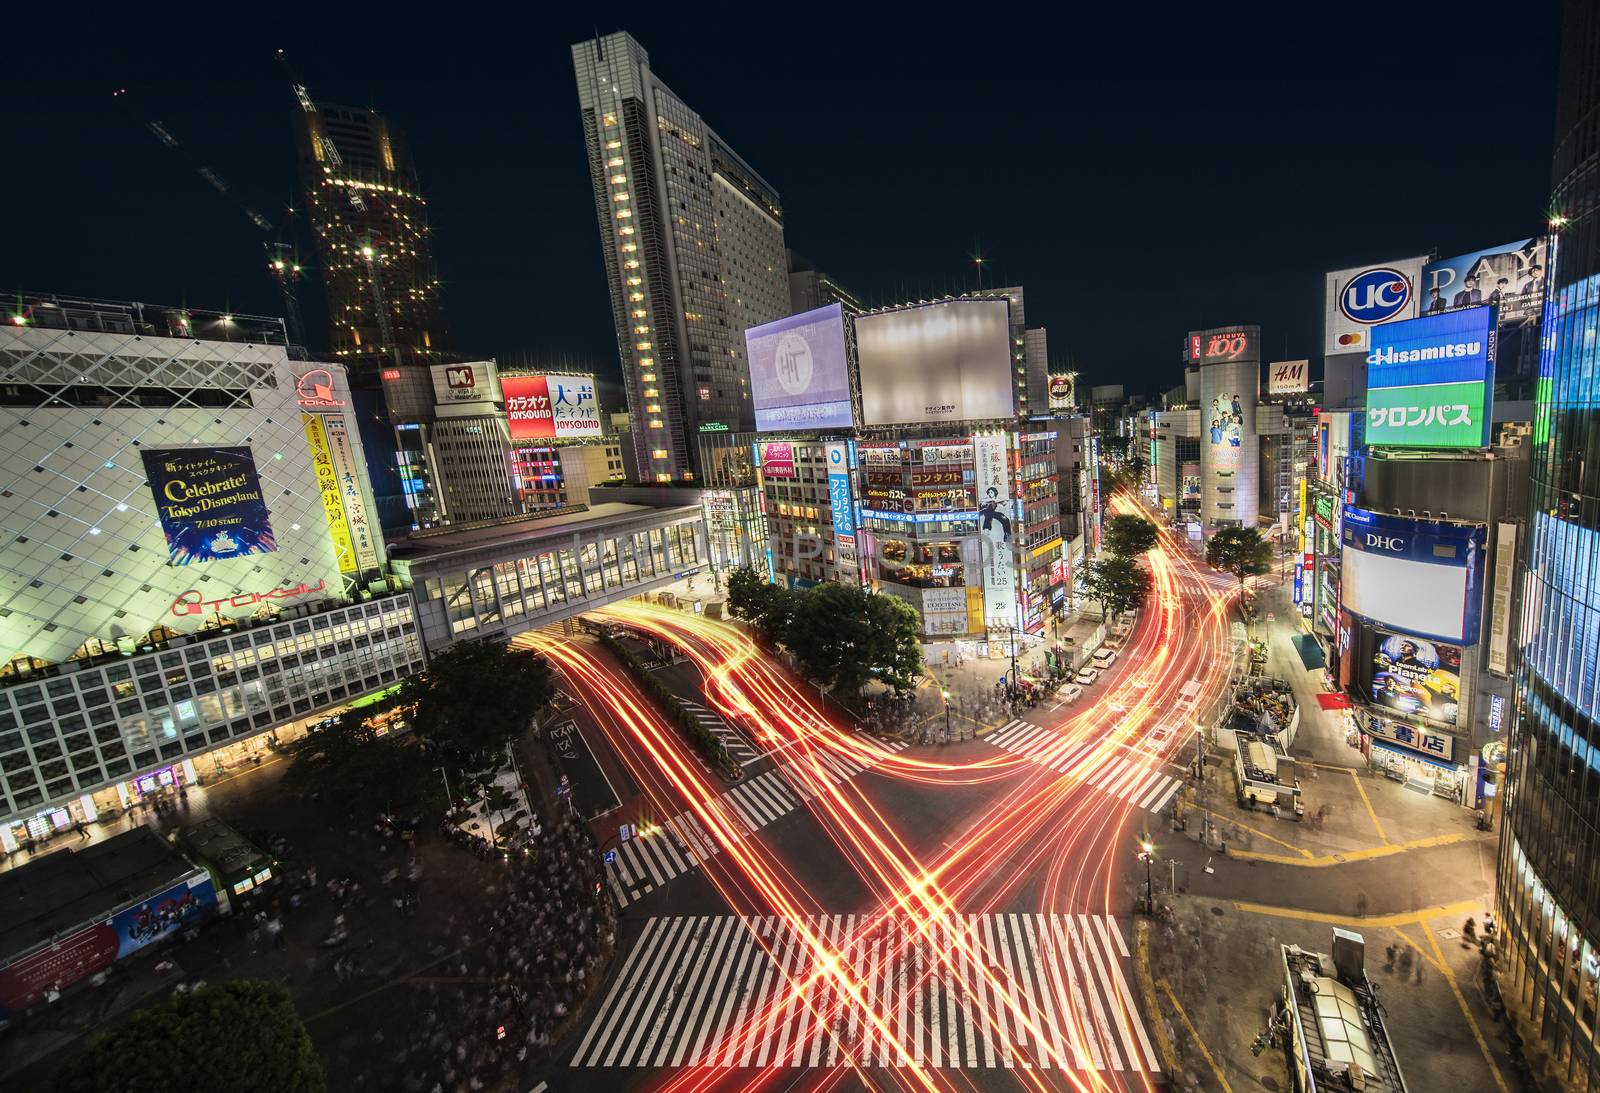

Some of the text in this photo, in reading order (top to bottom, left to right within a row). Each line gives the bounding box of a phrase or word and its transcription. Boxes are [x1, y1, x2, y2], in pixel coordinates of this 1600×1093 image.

[1429, 245, 1545, 290] DAY
[1205, 338, 1247, 359] 109
[1366, 342, 1481, 365] Hisamitsu
[1275, 365, 1304, 382] H&M
[508, 396, 548, 411] カラオケ
[551, 384, 593, 407] 大声
[510, 409, 552, 420] JOYSOUND
[1369, 405, 1472, 427] サロンパス
[557, 420, 599, 429] JOYSOUND
[164, 473, 247, 502] Celebrate!
[912, 473, 960, 483] コンタクト
[889, 490, 906, 499] ガスト
[948, 489, 970, 498] ガスト
[161, 491, 259, 518] Tokyo Disneyland
[831, 479, 844, 531] アイシティ
[841, 479, 851, 531] コンタクトの
[881, 499, 901, 510] ガスト
[195, 518, 217, 528] 7/10
[1366, 533, 1404, 552] DHC
[201, 579, 325, 611] TOKYU
[1396, 661, 1427, 673] teamLab
